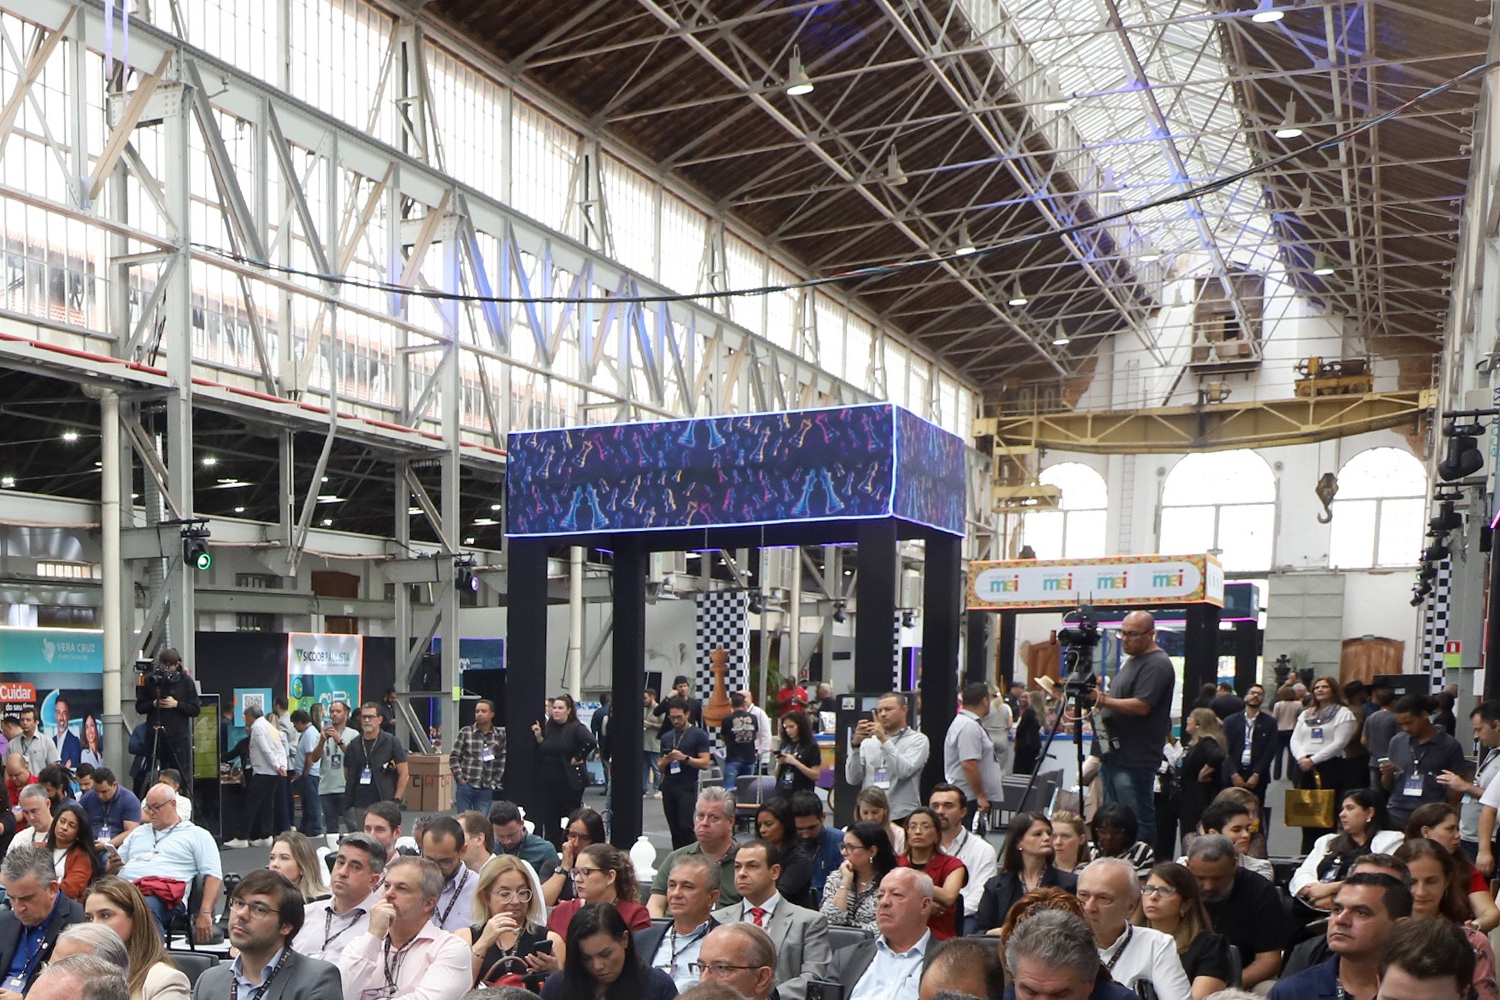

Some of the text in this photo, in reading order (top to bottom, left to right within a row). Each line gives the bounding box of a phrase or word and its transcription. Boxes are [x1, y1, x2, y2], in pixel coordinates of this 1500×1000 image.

[990, 574, 1019, 592] mei
[1043, 572, 1073, 591] mei
[1098, 571, 1127, 589] mei
[1153, 569, 1184, 587] mei
[57, 642, 96, 653] VERA CRUZ
[303, 650, 350, 662] SICOOB PAULISTA
[0, 685, 32, 700] Cuidar
